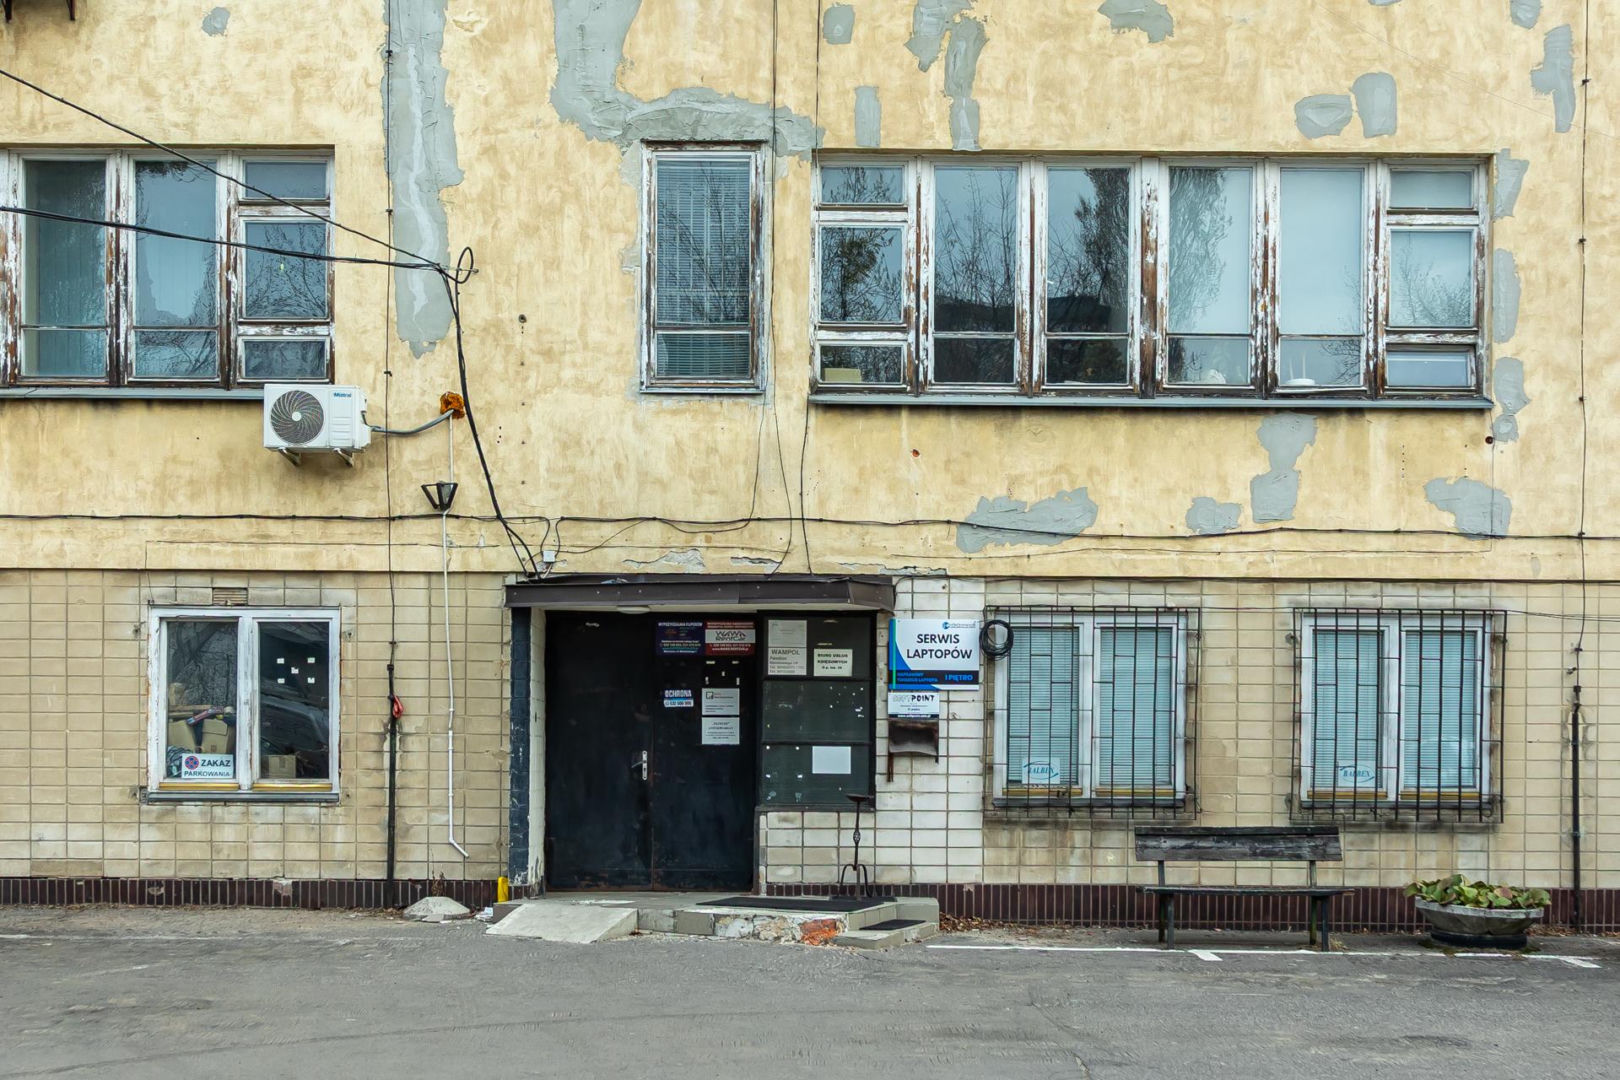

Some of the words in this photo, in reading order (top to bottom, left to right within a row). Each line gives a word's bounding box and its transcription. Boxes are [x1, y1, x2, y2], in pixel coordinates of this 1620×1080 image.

[916, 633, 960, 644] SERWIS
[906, 646, 973, 659] LAPTOPÓW
[949, 674, 973, 682] PIĘTRO
[664, 689, 692, 698] OCHRONA
[201, 759, 231, 767] ZAKAZ
